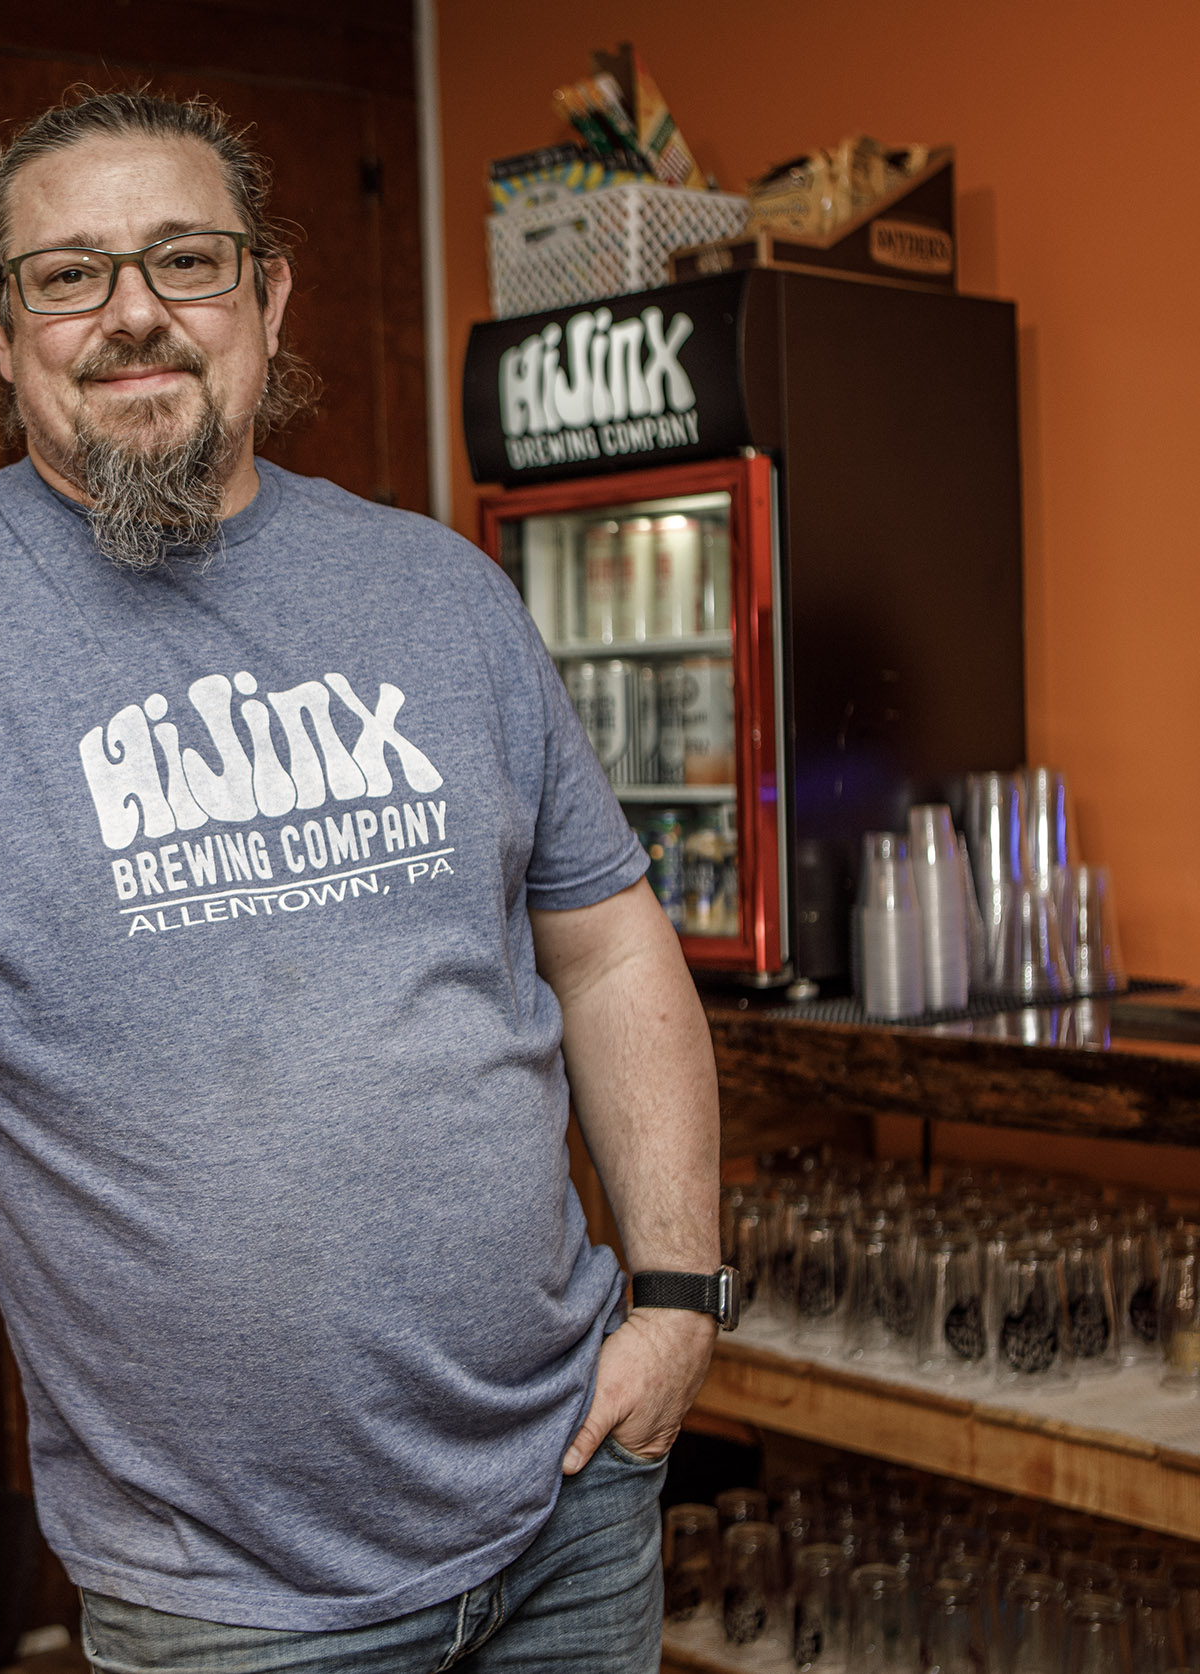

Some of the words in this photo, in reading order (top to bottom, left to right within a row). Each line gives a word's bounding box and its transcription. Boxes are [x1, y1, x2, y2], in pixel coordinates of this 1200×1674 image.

[505, 427, 600, 470] BREWING
[601, 409, 699, 456] COMPANY
[112, 831, 273, 900] BREWING
[280, 801, 447, 874] COMPANY
[128, 874, 390, 937] ALLENTOWN,
[407, 857, 455, 884] PA
